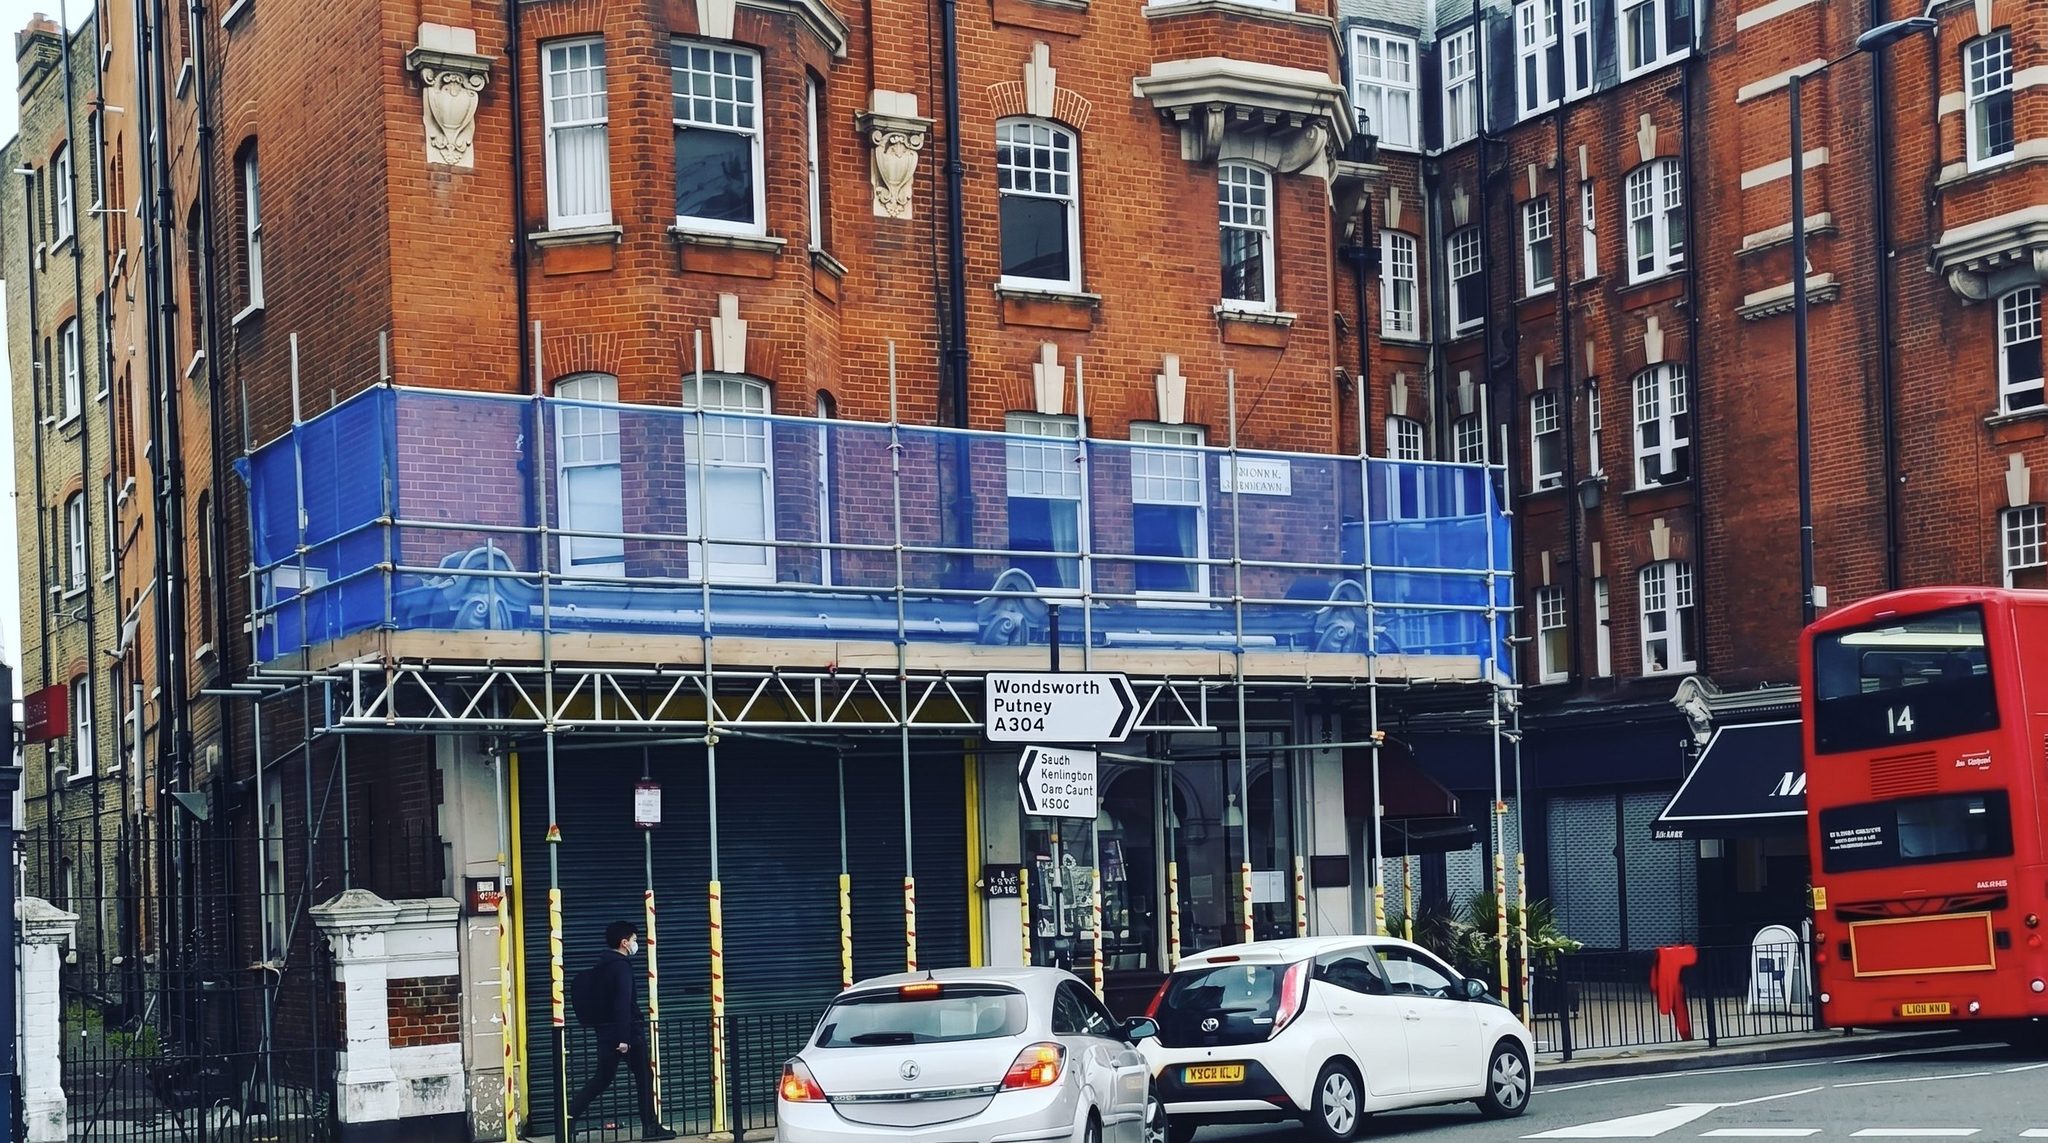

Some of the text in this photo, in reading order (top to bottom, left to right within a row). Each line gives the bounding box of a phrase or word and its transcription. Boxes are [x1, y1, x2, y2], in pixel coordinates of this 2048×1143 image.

[994, 698, 1053, 716] Putney
[994, 717, 1045, 732] A304
[1887, 705, 1914, 734] 14
